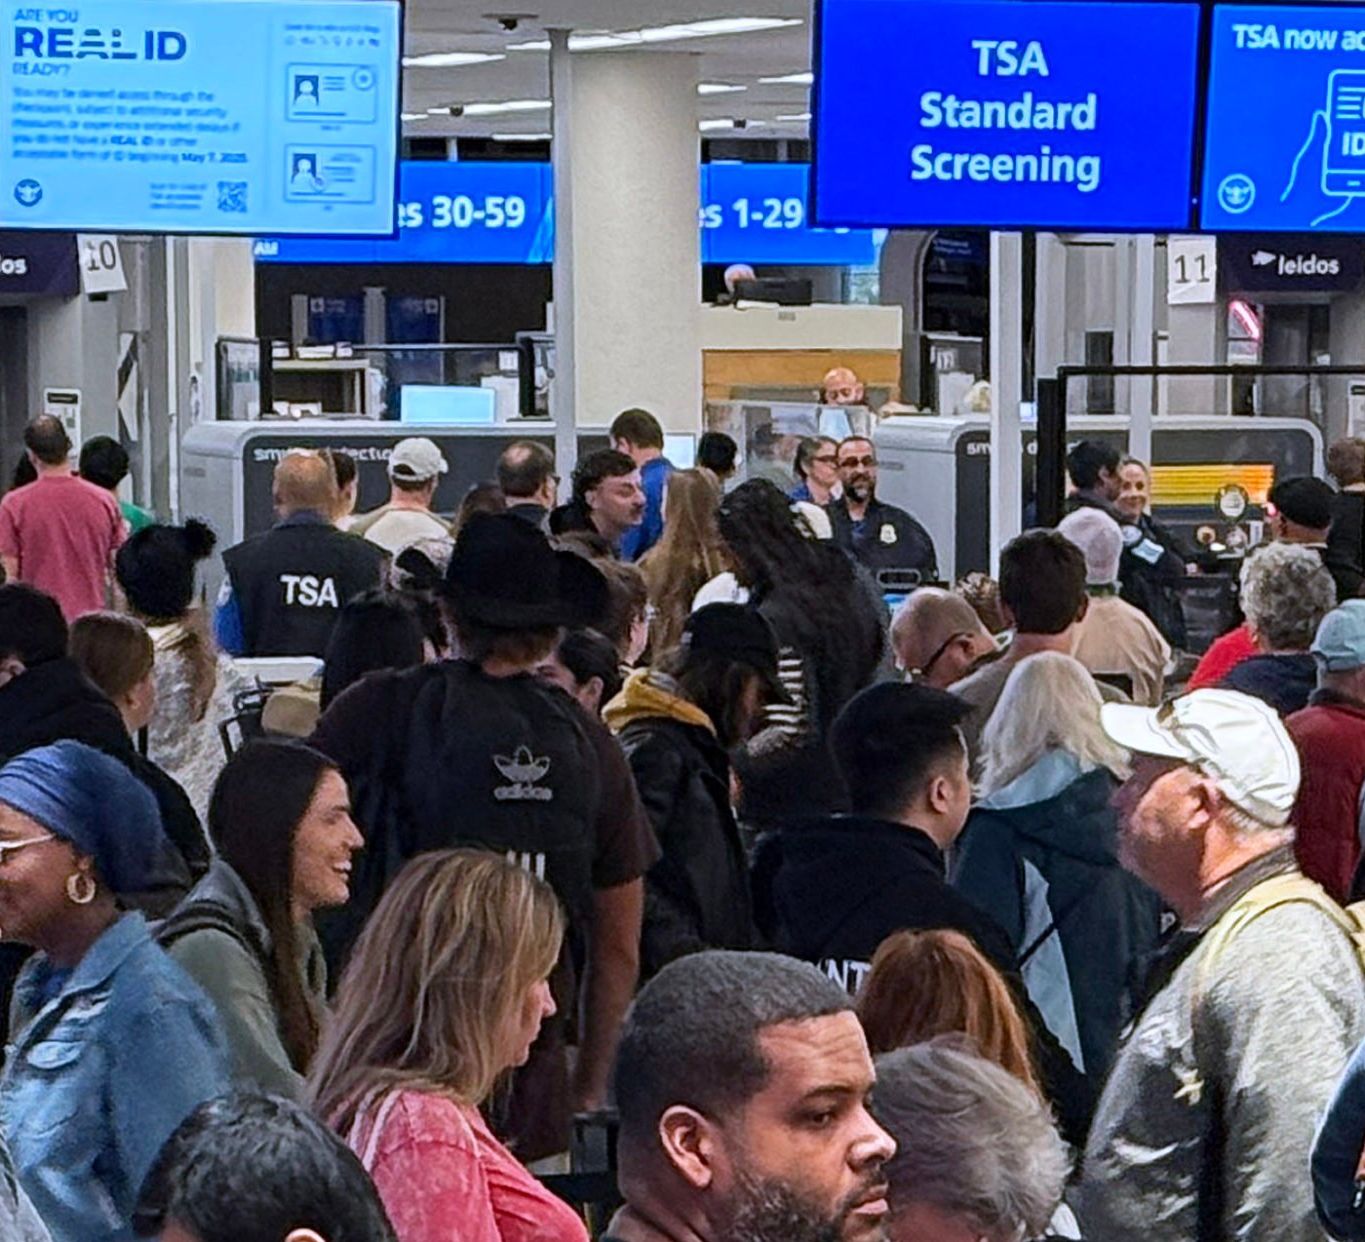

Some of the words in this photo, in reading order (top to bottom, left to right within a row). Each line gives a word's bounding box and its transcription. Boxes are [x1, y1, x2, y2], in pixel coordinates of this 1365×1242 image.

[14, 9, 42, 22] ARE
[47, 10, 78, 22] YOU
[14, 27, 137, 59] REAL
[144, 30, 187, 60] ID
[1232, 24, 1280, 49] TSA
[1284, 29, 1337, 50] now
[971, 40, 1050, 77] TSA
[919, 91, 1097, 130] Standard
[911, 144, 1101, 192] Screening
[432, 195, 525, 228] 30-59
[732, 197, 804, 229] 1-29
[1174, 253, 1211, 284] 11
[1278, 254, 1340, 276] leidos
[280, 574, 338, 607] TSA
[494, 783, 553, 800] adidas
